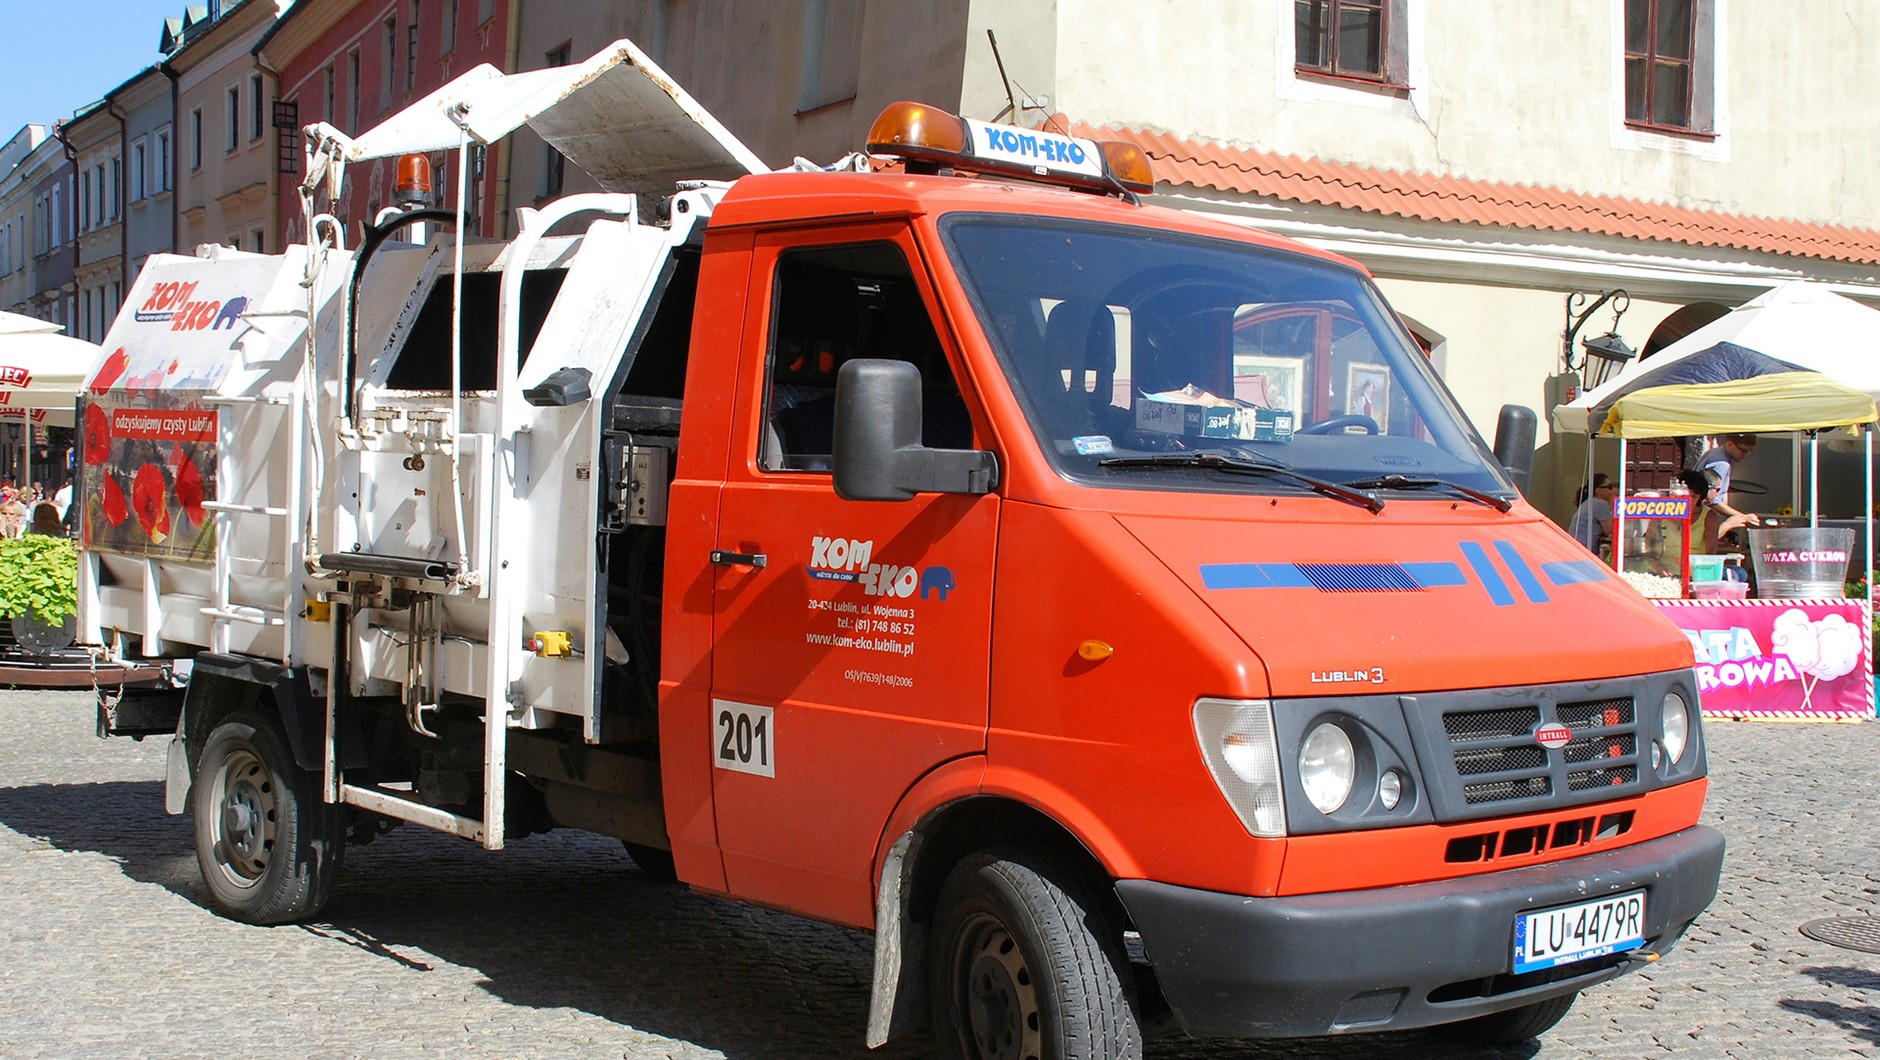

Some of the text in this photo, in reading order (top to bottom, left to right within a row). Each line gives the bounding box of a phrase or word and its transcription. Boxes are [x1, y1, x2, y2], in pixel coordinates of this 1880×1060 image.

[984, 127, 1086, 165] KOM-EKO
[141, 280, 200, 311] KOM
[115, 414, 213, 435] odzyskujemy czysty Lublin
[810, 536, 874, 572] KOM
[1762, 551, 1798, 563] WATA
[807, 599, 915, 619] 20-424 Lublin, ul. Wojenna 3
[855, 618, 871, 634] (81)
[872, 620, 888, 632] 748
[889, 622, 902, 634] 86
[903, 623, 915, 636] 52
[806, 633, 914, 657] www.kom-eko.lublin.pl
[1311, 667, 1384, 684] LUBLIN 3
[1696, 656, 1798, 692] ROWA
[719, 710, 767, 766] 201
[1539, 730, 1569, 740] INTRALL
[1532, 898, 1640, 957] LU 4479R
[1515, 946, 1524, 957] PL
